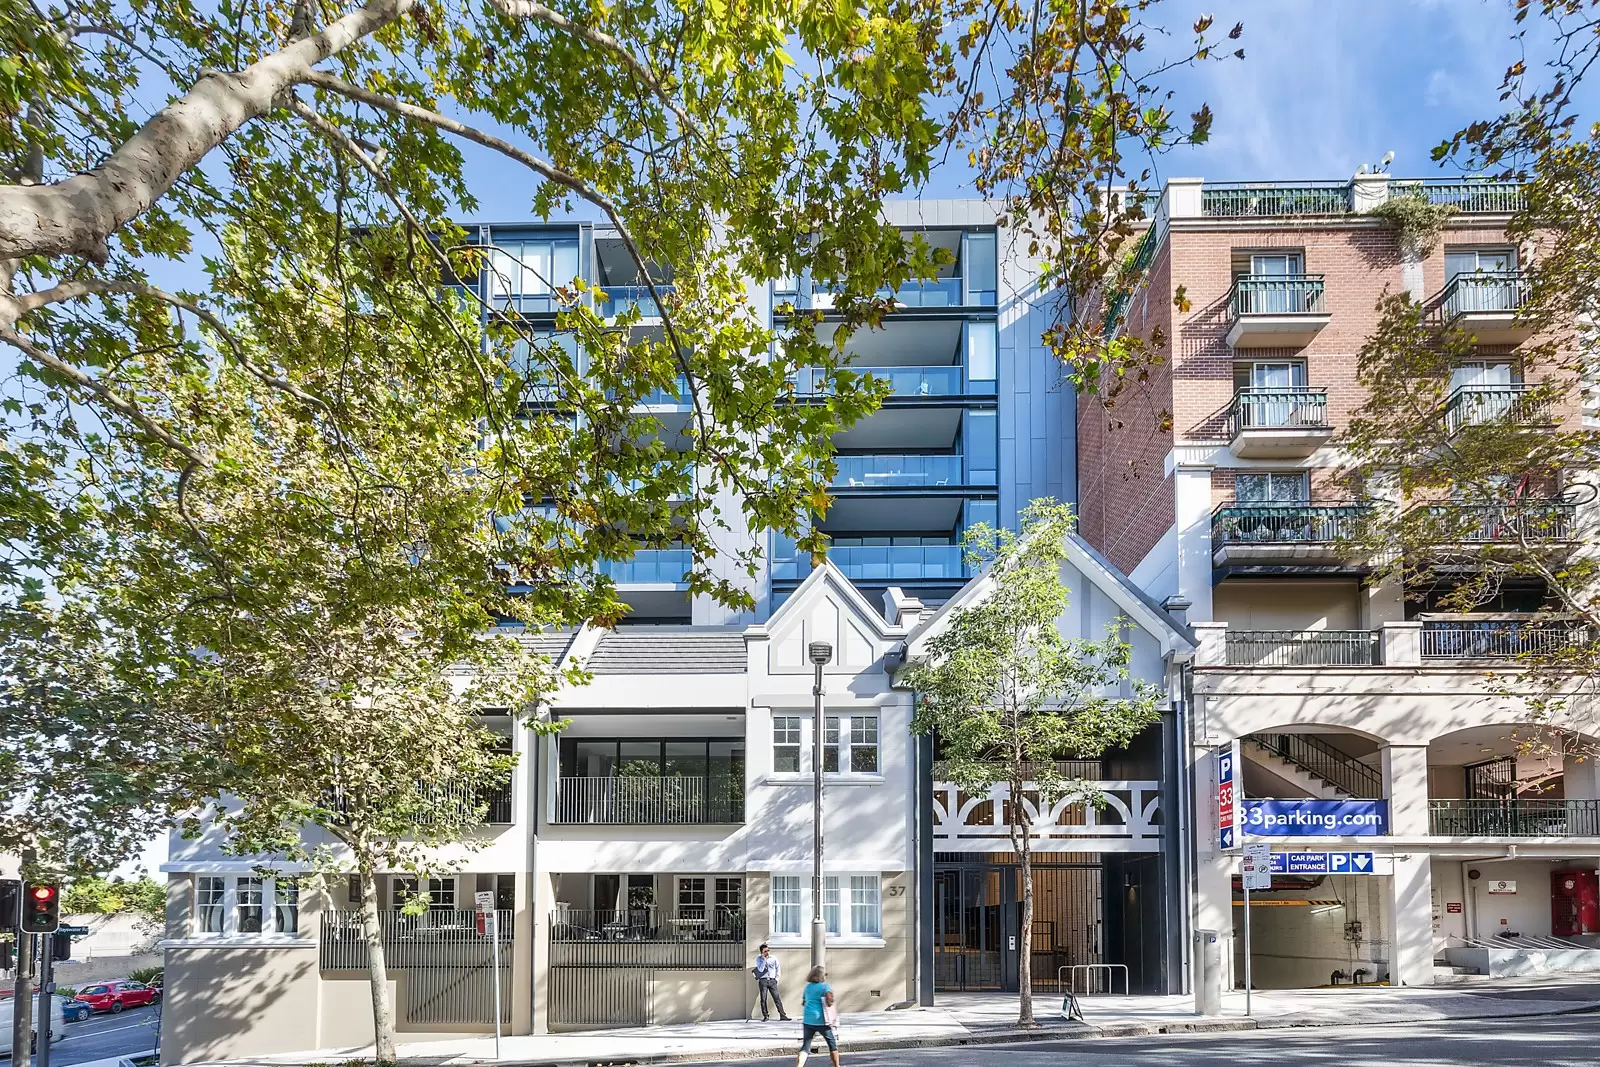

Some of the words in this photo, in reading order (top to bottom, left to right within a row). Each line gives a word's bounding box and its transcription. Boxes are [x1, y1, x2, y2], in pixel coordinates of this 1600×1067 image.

[1221, 757, 1231, 780] P
[1220, 787, 1232, 806] 33
[1290, 863, 1326, 871] ENTRANCE
[1332, 854, 1347, 871] P
[889, 886, 906, 896] 37
